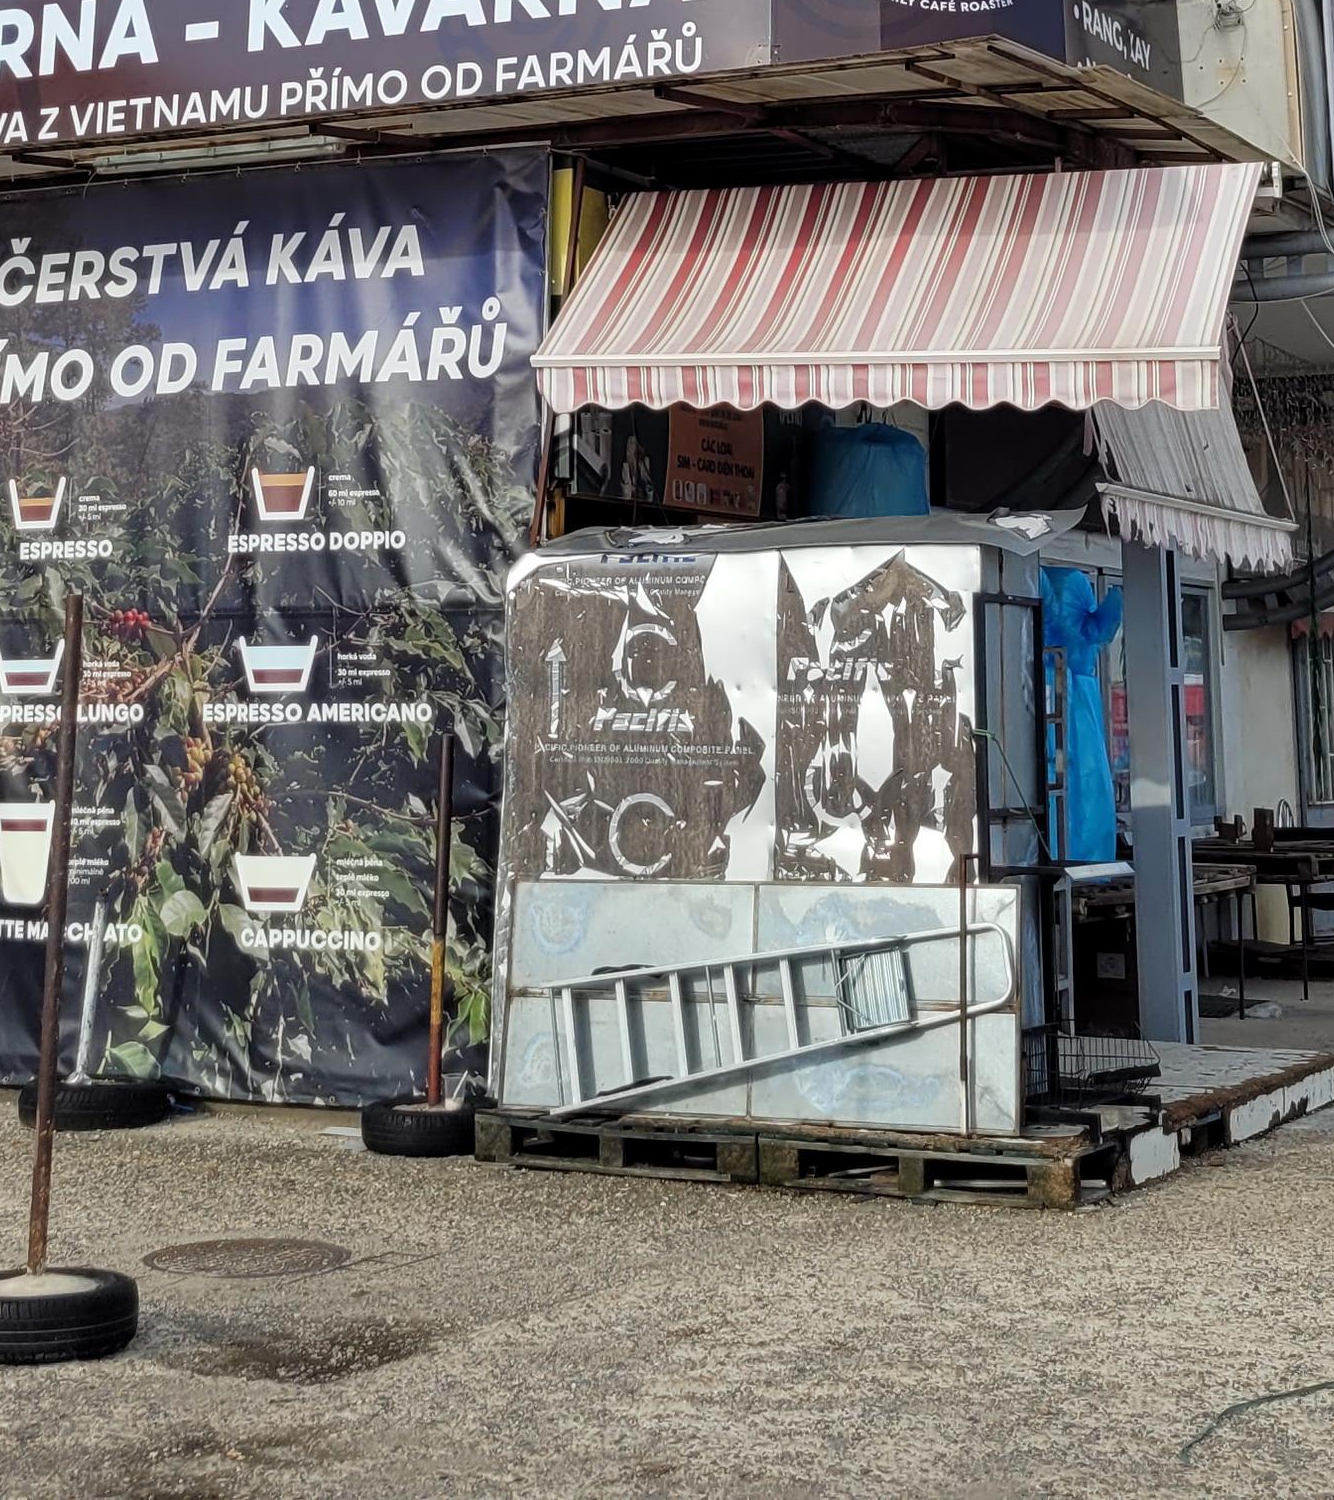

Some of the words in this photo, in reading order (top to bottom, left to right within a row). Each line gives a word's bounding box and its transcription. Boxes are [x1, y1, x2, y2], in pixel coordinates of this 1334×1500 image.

[184, 20, 220, 42] -
[1082, 0, 1128, 61] RANG,
[38, 107, 60, 140] Z
[69, 84, 269, 138] VIETNAMU
[280, 65, 408, 115] PŘÍMO
[421, 64, 484, 98] OD
[495, 21, 704, 92] FARMÁŘŮ
[265, 212, 425, 286] KÁVA
[109, 342, 198, 398] OD
[210, 296, 508, 391] FARMÁŘŮ
[328, 474, 352, 482] crema
[19, 540, 113, 560] ESPRESSO
[227, 532, 326, 553] ESPRESSO
[329, 530, 406, 551] DOPPIO
[337, 652, 357, 661] horká
[358, 652, 377, 661] voda
[337, 668, 347, 677] 30
[348, 668, 357, 677] ml
[353, 678, 363, 686] ml
[76, 703, 144, 723] LUNGO
[202, 702, 303, 723] ESPRESSO
[307, 702, 433, 722] AMERICANO
[27, 920, 143, 943] MACHATO
[240, 928, 381, 950] CAPPUCCINO
